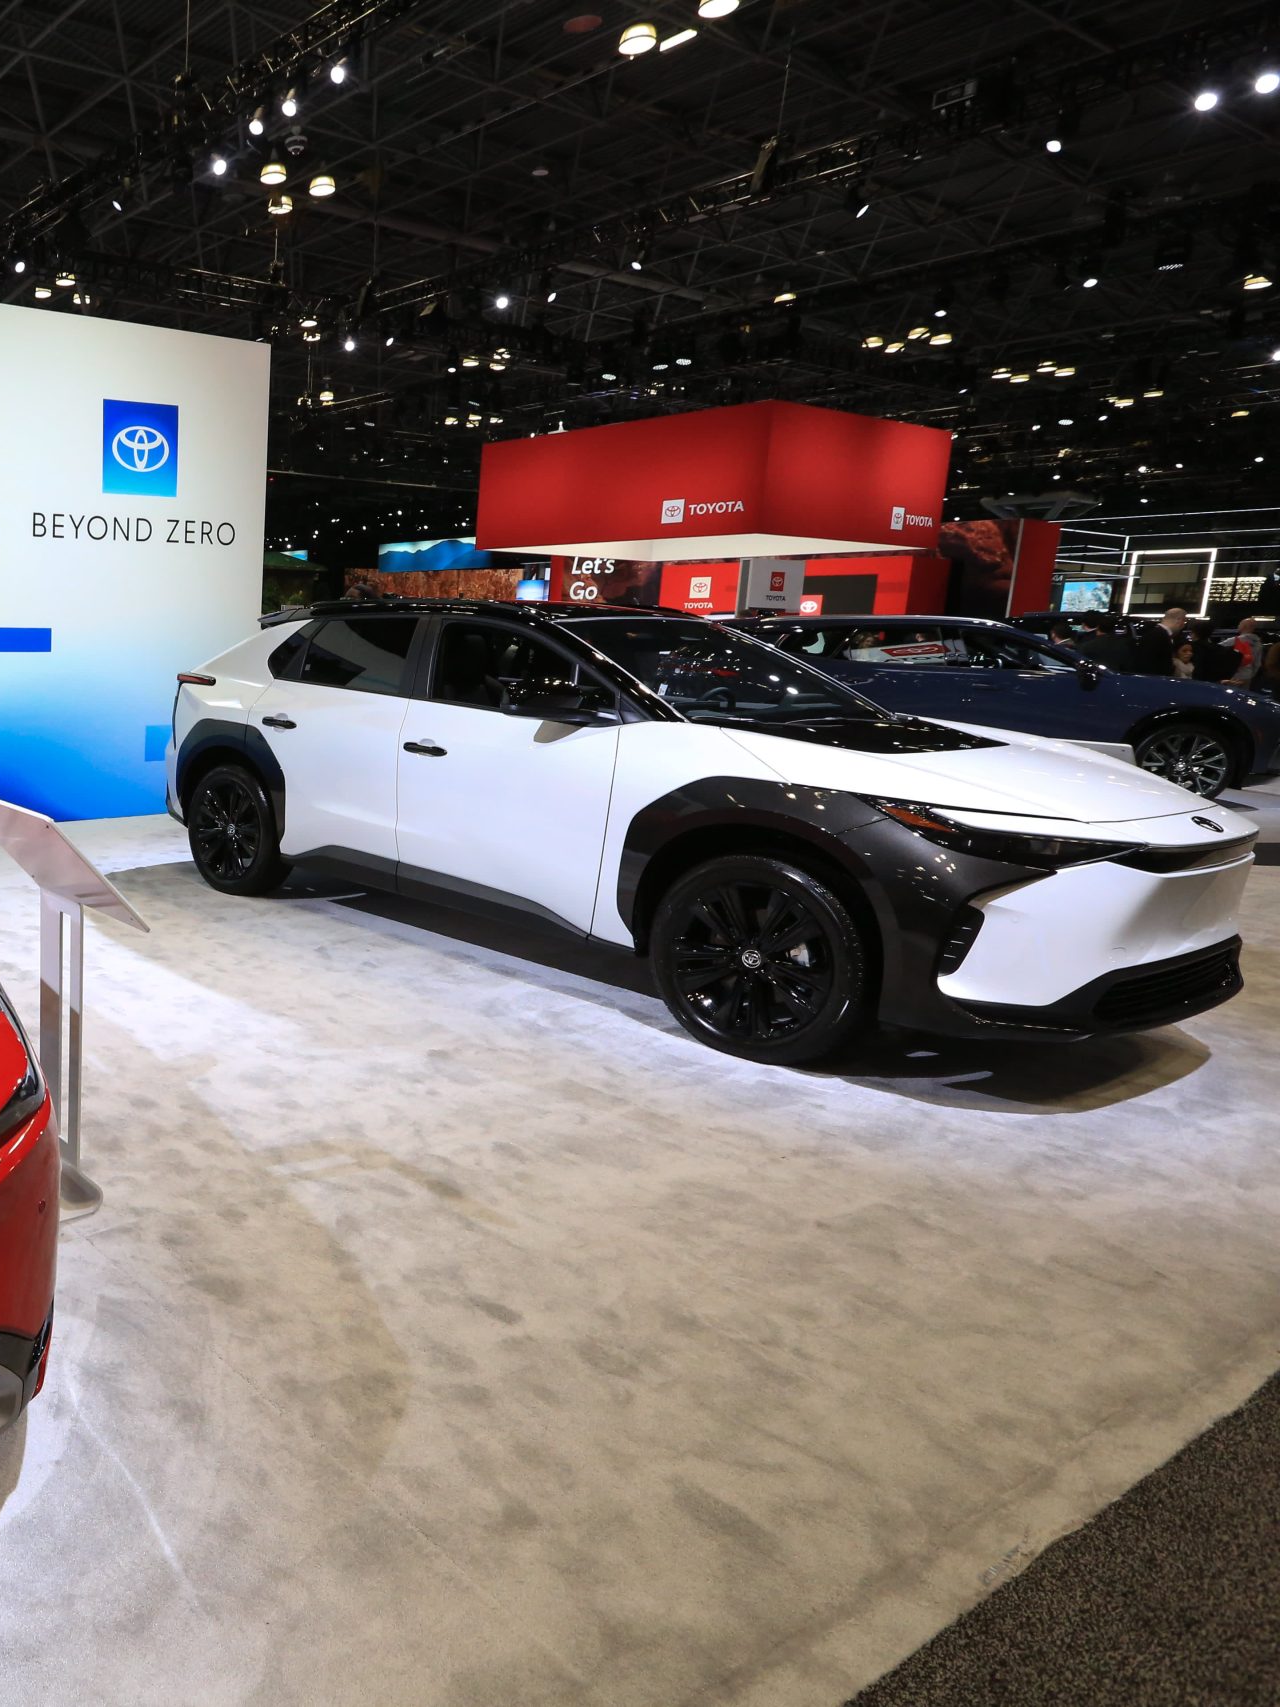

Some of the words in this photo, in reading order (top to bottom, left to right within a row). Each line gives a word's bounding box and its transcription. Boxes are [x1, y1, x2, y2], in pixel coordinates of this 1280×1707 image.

[689, 500, 744, 516] TOYOTA
[32, 512, 152, 542] BEYOND
[166, 519, 236, 546] ZERO
[905, 514, 933, 527] TOYOTA
[571, 556, 615, 575] Let's
[569, 581, 598, 600] Go
